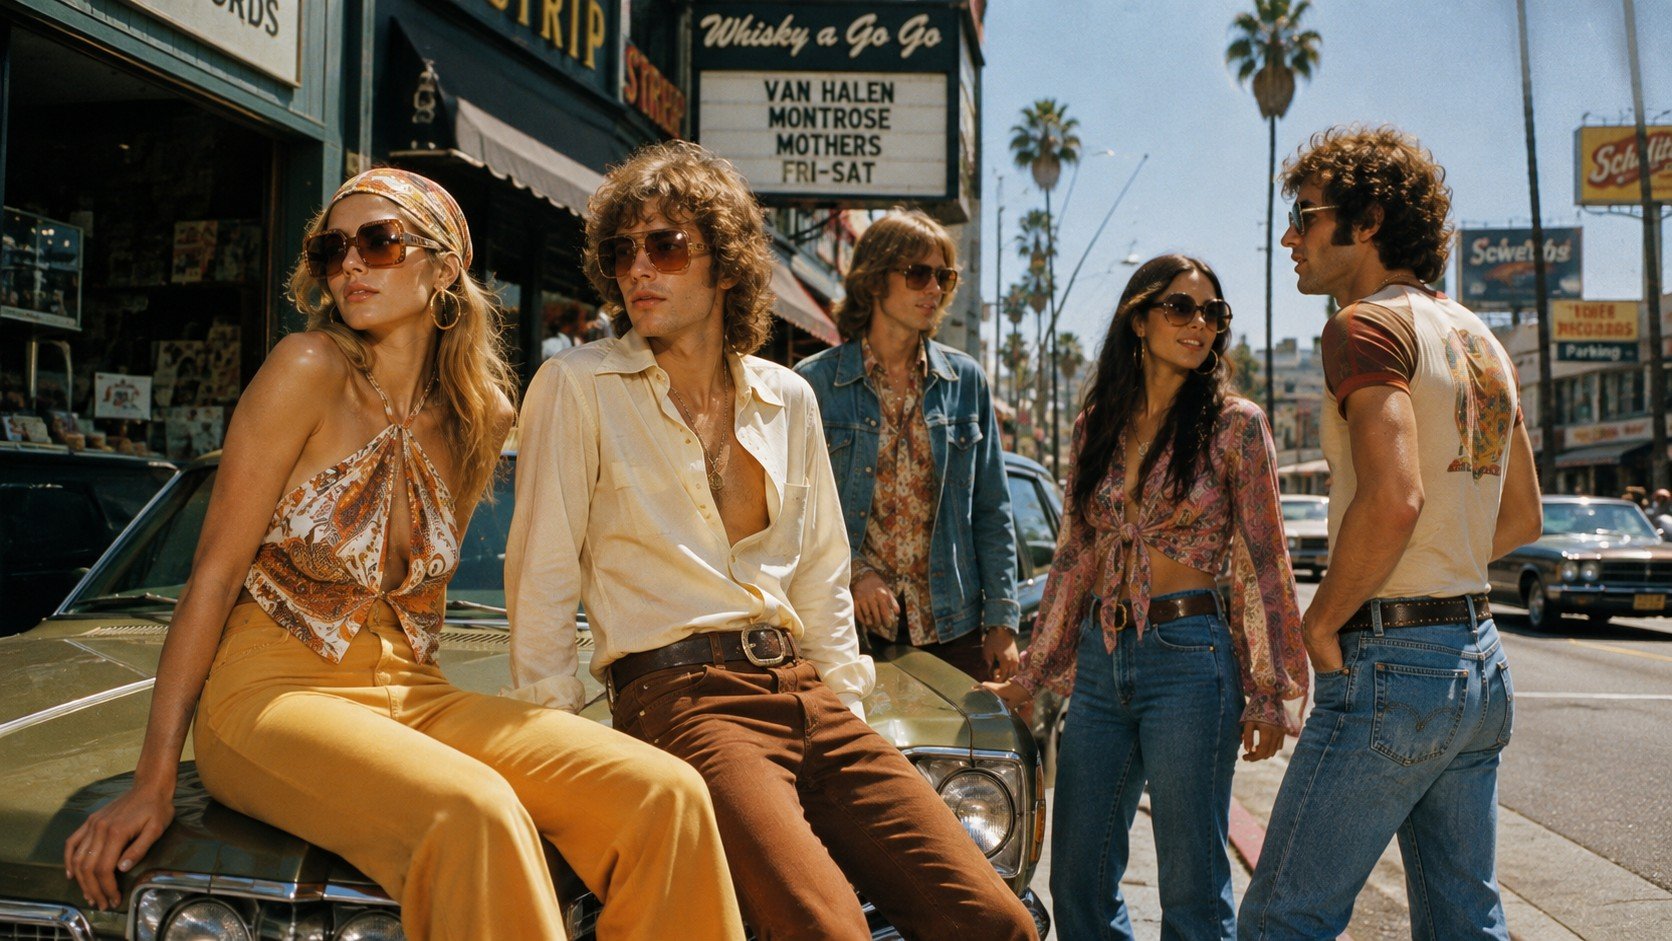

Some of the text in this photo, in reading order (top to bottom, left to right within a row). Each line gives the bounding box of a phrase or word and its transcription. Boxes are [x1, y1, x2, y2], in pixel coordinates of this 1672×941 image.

[211, 0, 280, 37] RDS
[488, 0, 605, 71] RIP
[700, 12, 942, 58] Whisky a Go Go
[764, 80, 894, 103] VAN HALEN
[769, 106, 891, 129] MONTROSE
[776, 133, 882, 156] MOTHERS
[782, 160, 876, 183] FRI-SAT
